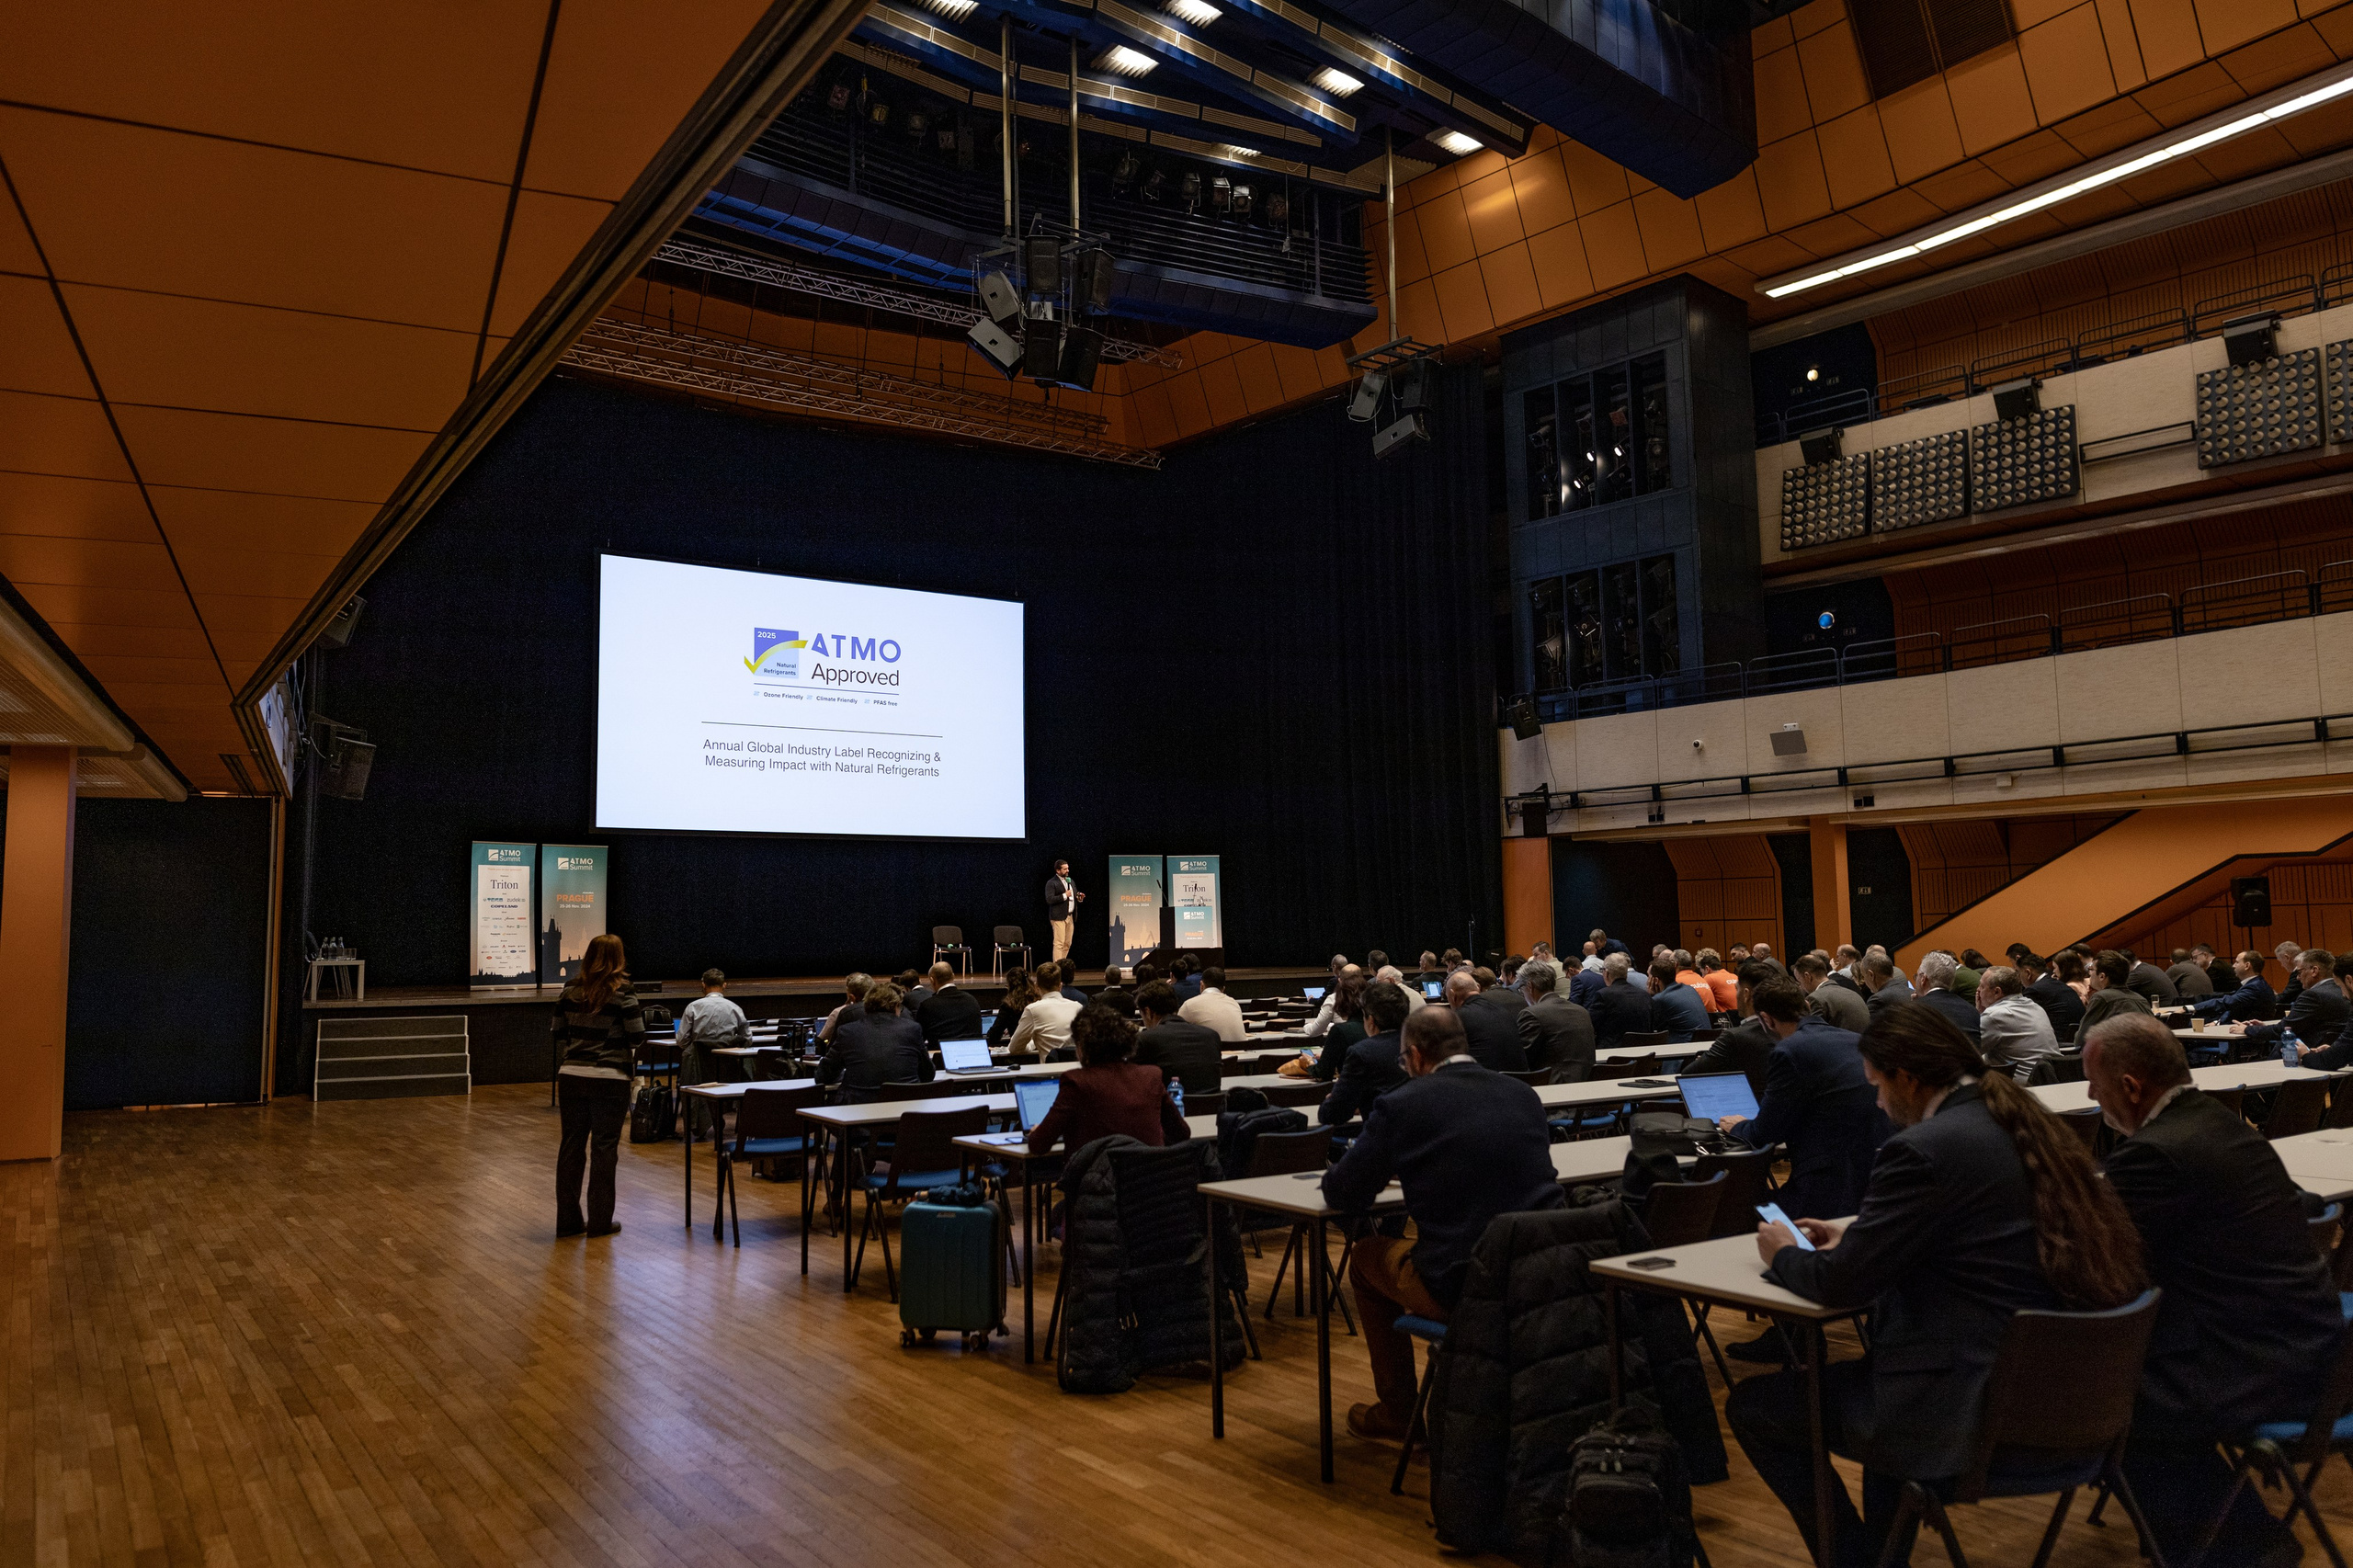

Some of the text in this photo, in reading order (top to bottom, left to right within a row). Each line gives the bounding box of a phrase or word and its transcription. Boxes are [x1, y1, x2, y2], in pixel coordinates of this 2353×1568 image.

[757, 631, 777, 639] 2025
[811, 632, 901, 663] ATMO
[777, 661, 797, 669] Natural
[763, 667, 796, 676] Refrigerants
[811, 663, 899, 686] Approved
[703, 739, 941, 764] Annual Global Industry Label Recognizing &
[705, 756, 939, 778] Measuring Impact with Natural Refrigerants
[491, 880, 518, 890] Triton
[557, 894, 594, 903] PRAGUE
